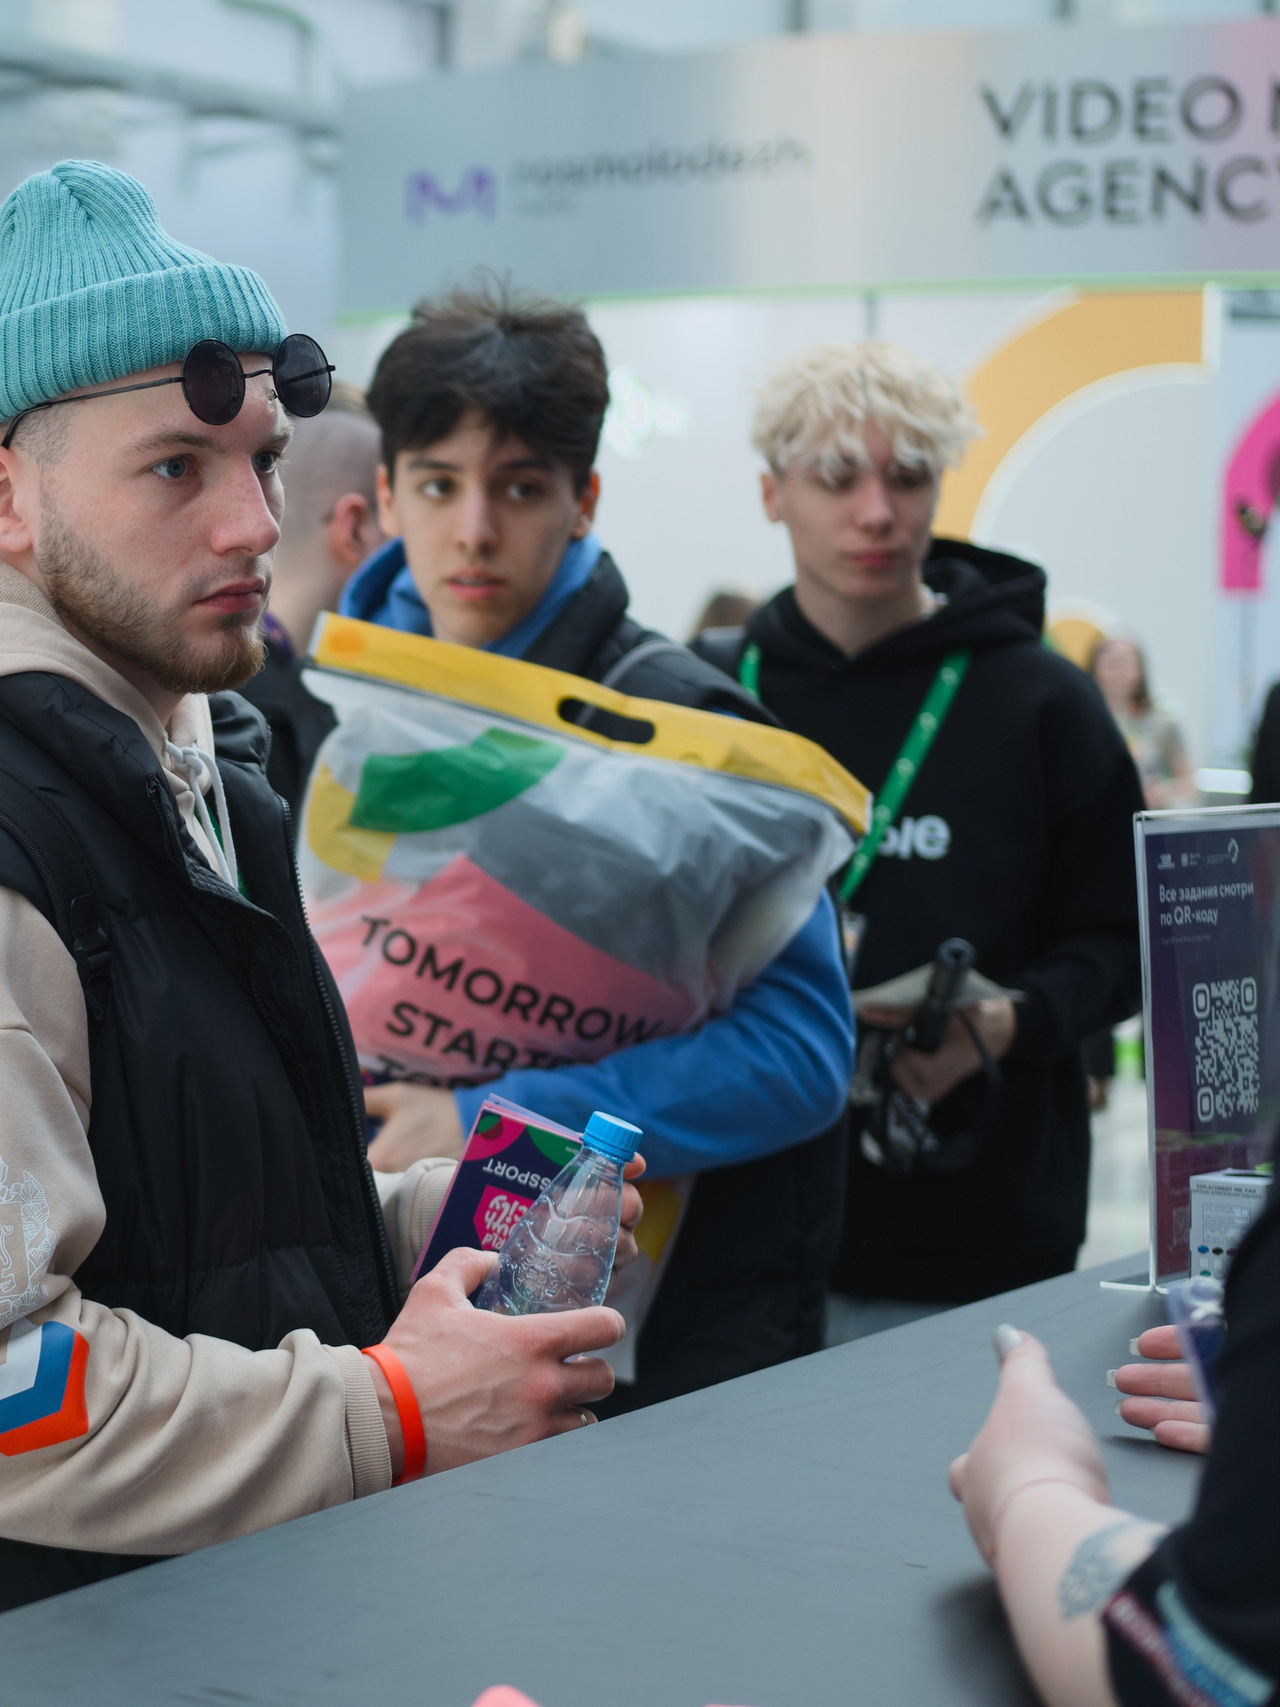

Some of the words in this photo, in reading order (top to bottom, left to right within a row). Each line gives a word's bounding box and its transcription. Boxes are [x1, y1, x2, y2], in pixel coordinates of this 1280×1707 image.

[981, 77, 1242, 143] VIDEO
[977, 157, 1280, 226] AGENC
[1159, 884, 1177, 903] Все
[1179, 885, 1218, 902] задания
[1219, 882, 1254, 900] смотри
[1160, 912, 1172, 926] по
[1174, 905, 1218, 925] QR-коду
[361, 915, 662, 1045] TOMORROW
[385, 1001, 576, 1072] START
